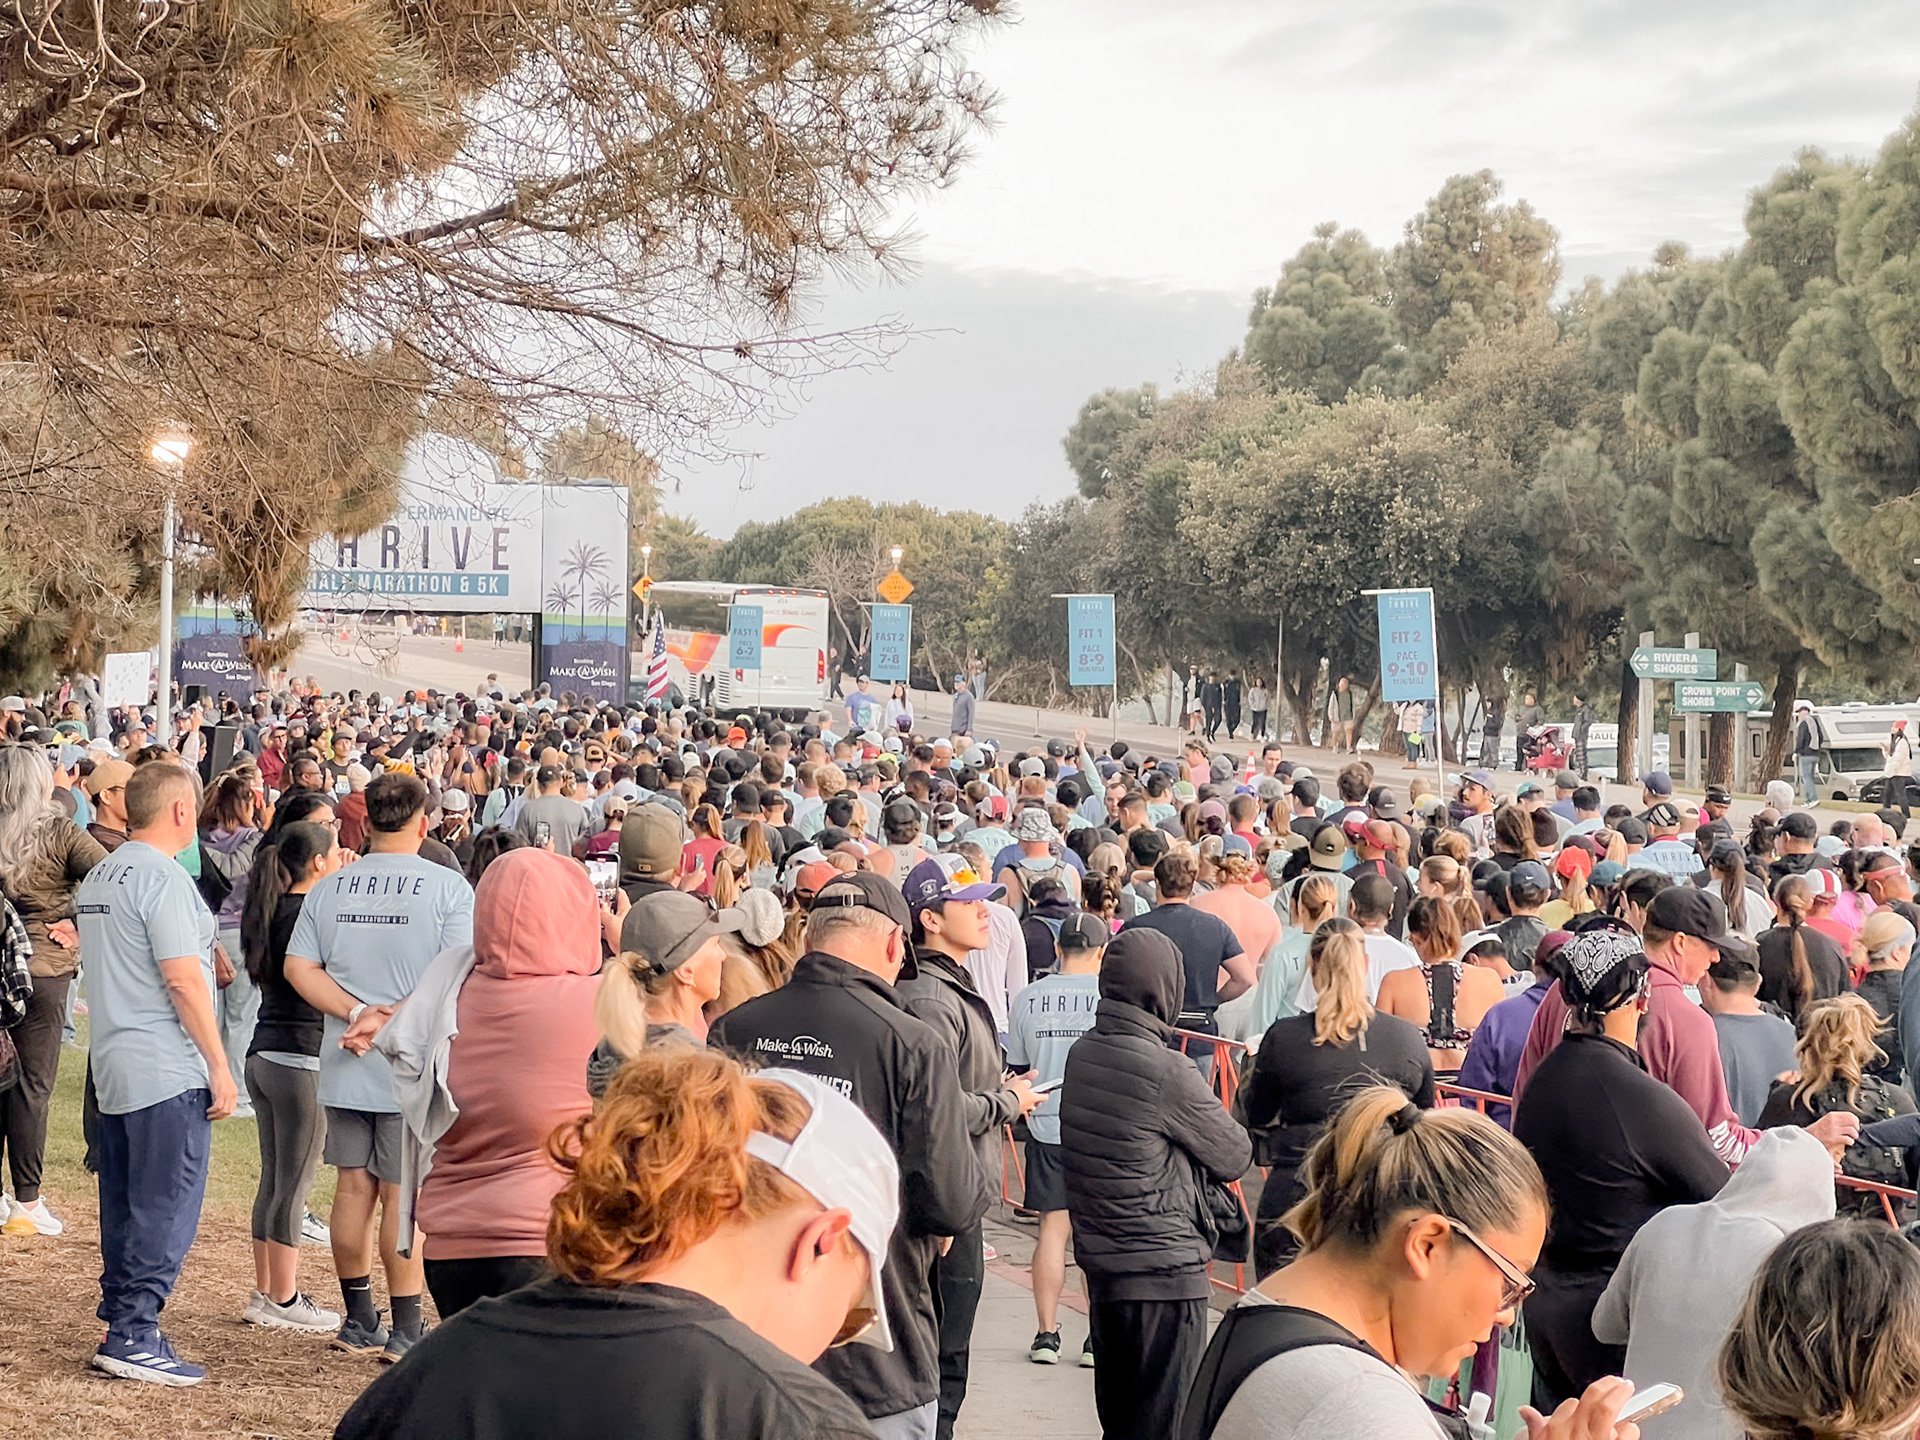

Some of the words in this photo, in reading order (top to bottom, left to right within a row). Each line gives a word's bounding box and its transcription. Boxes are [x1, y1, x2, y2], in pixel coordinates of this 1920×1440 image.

[337, 525, 510, 571] HRIVE
[358, 573, 451, 593] MARATHON
[460, 578, 469, 593] &
[477, 576, 499, 593] 5K
[733, 627, 752, 637] FAST
[754, 628, 759, 636] 1
[875, 632, 897, 642] FAST
[898, 632, 905, 641] 2
[1078, 628, 1094, 639] FIT
[1097, 628, 1103, 638] 1
[1391, 630, 1410, 643] FIT
[1413, 630, 1422, 643] 2
[736, 647, 755, 656] 6-7
[1082, 644, 1101, 653] PACE
[879, 654, 900, 665] 7-8
[1079, 653, 1105, 666] 8-9
[1397, 650, 1419, 661] PACE
[1653, 652, 1698, 663] RIVIERA
[1387, 661, 1429, 677] 9-10
[1653, 663, 1699, 674] SHORES
[1681, 686, 1712, 697] CROWN
[1715, 687, 1742, 697] POINT
[1681, 696, 1715, 707] SHORES
[335, 875, 425, 896] THRIVE
[1029, 995, 1095, 1014] THRIV
